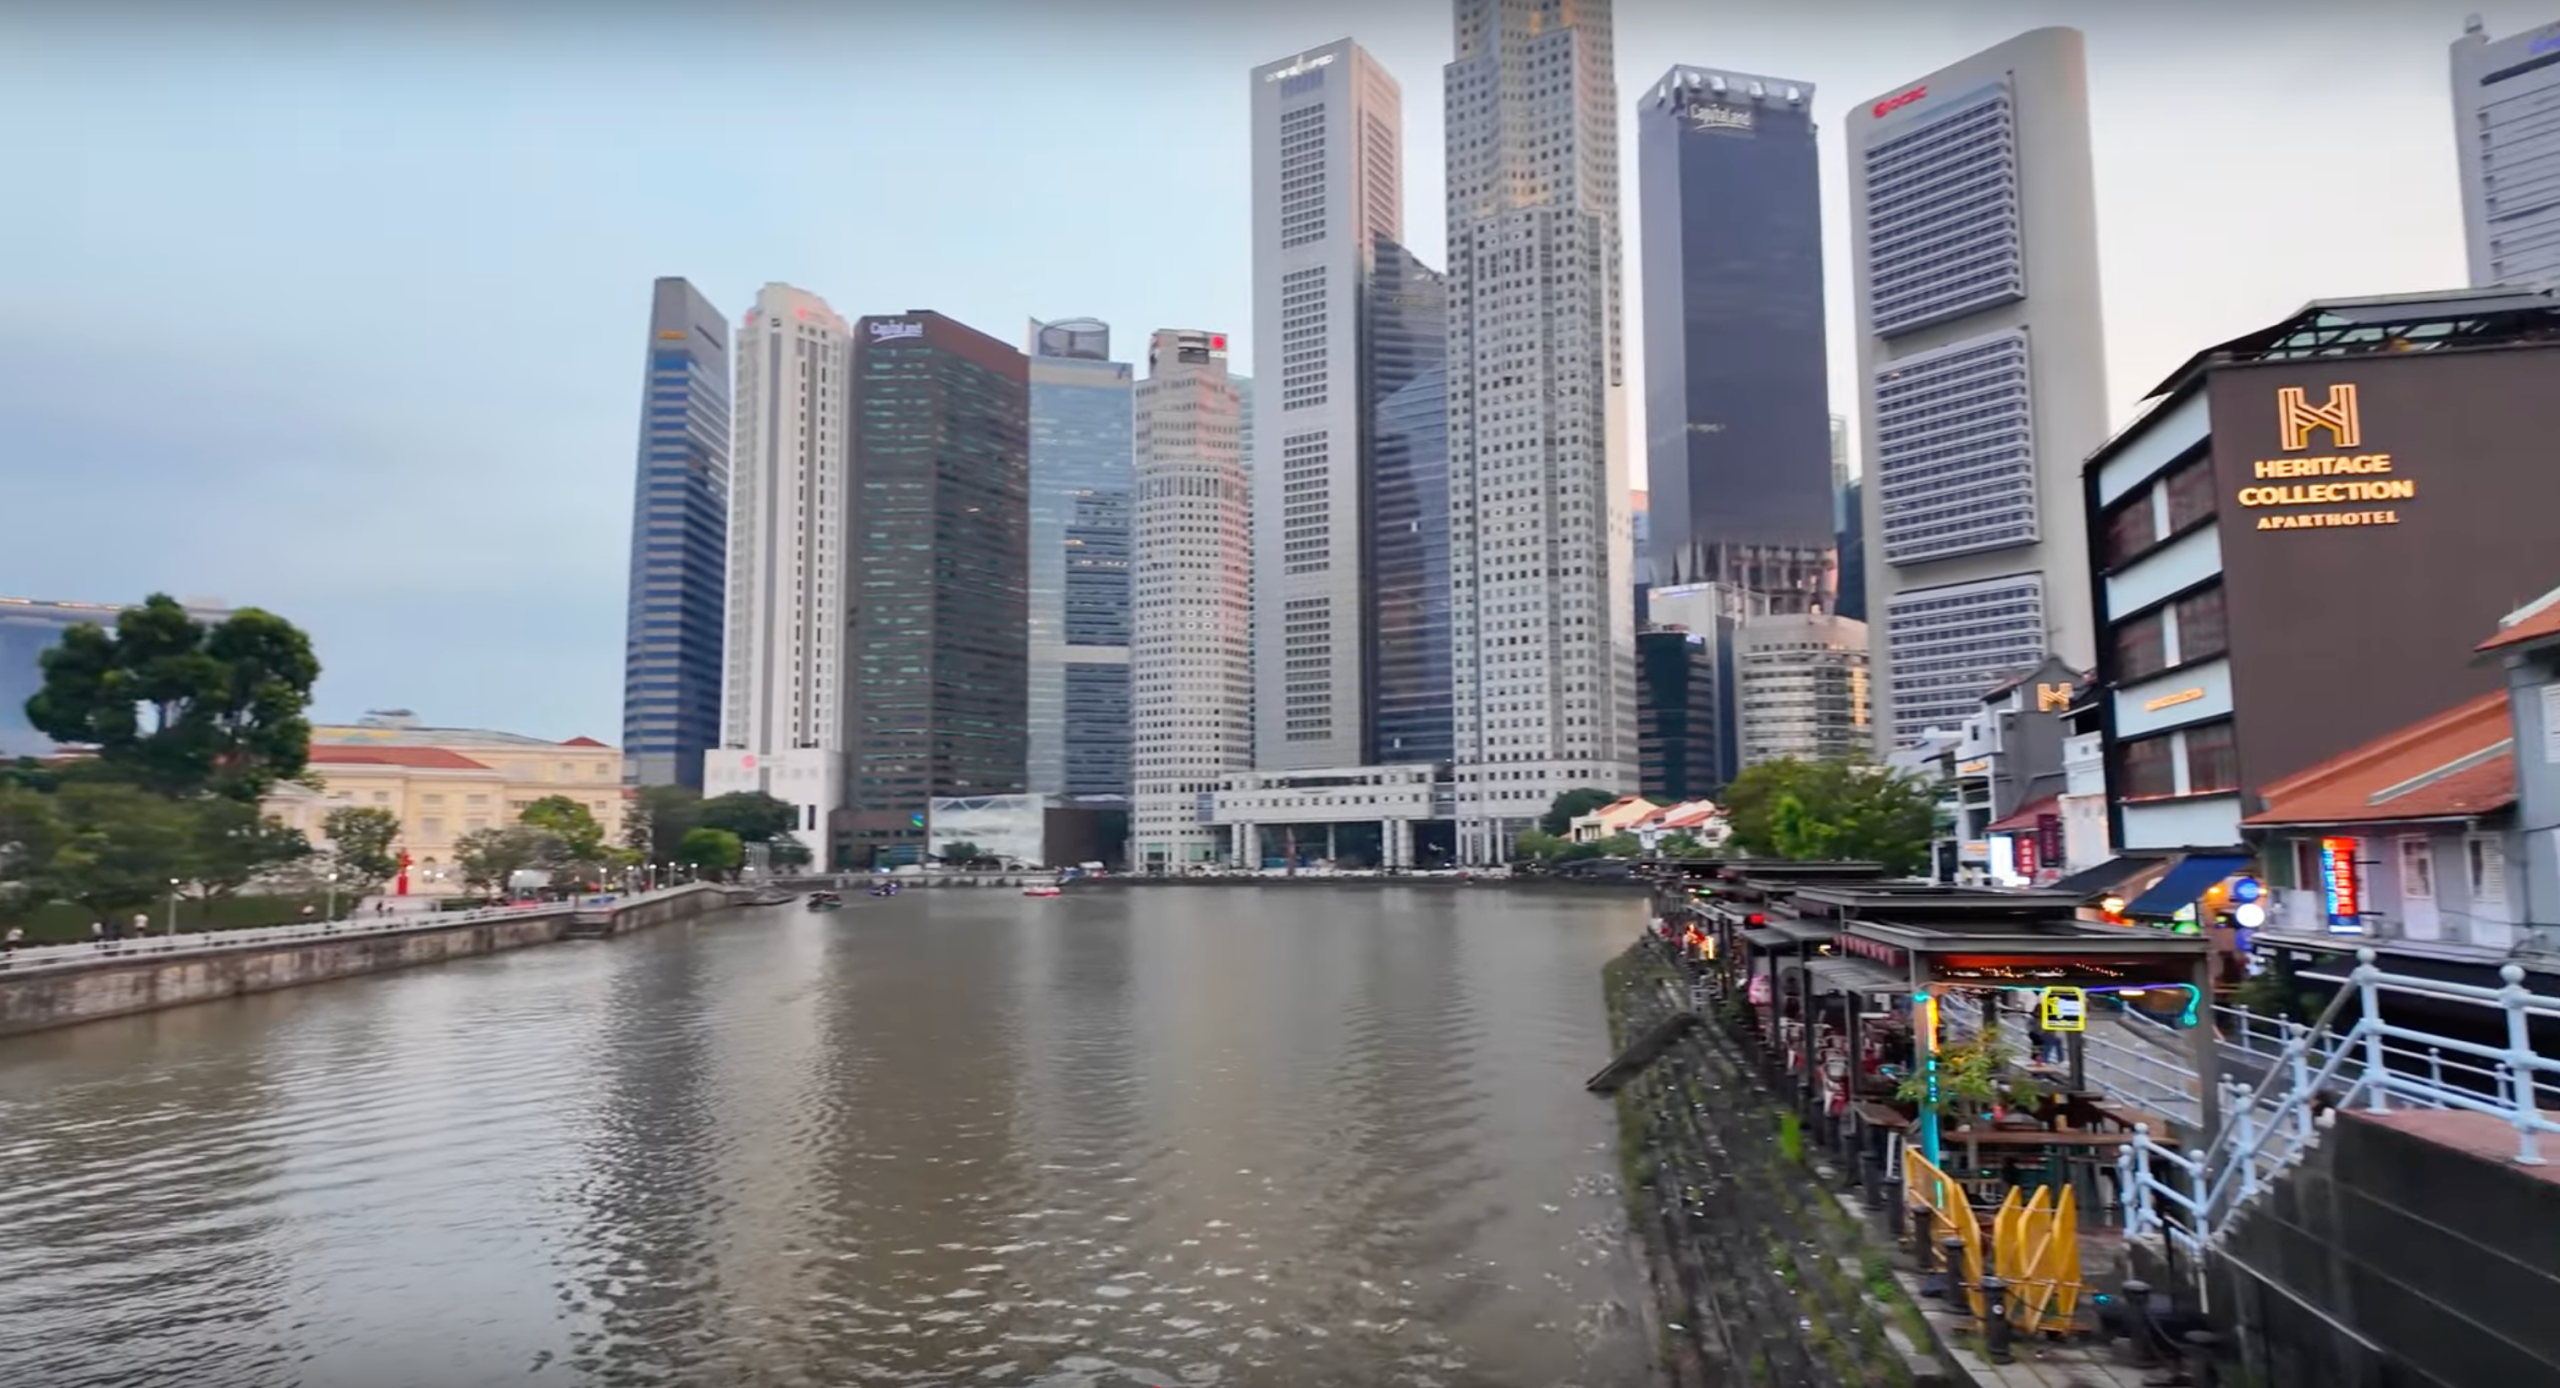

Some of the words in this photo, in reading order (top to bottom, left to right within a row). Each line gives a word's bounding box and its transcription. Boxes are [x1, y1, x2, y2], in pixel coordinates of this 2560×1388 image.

[2254, 454, 2392, 479] HERITAGE
[2238, 479, 2415, 507] COLLECTION
[2256, 510, 2400, 530] APARTHOTEL
